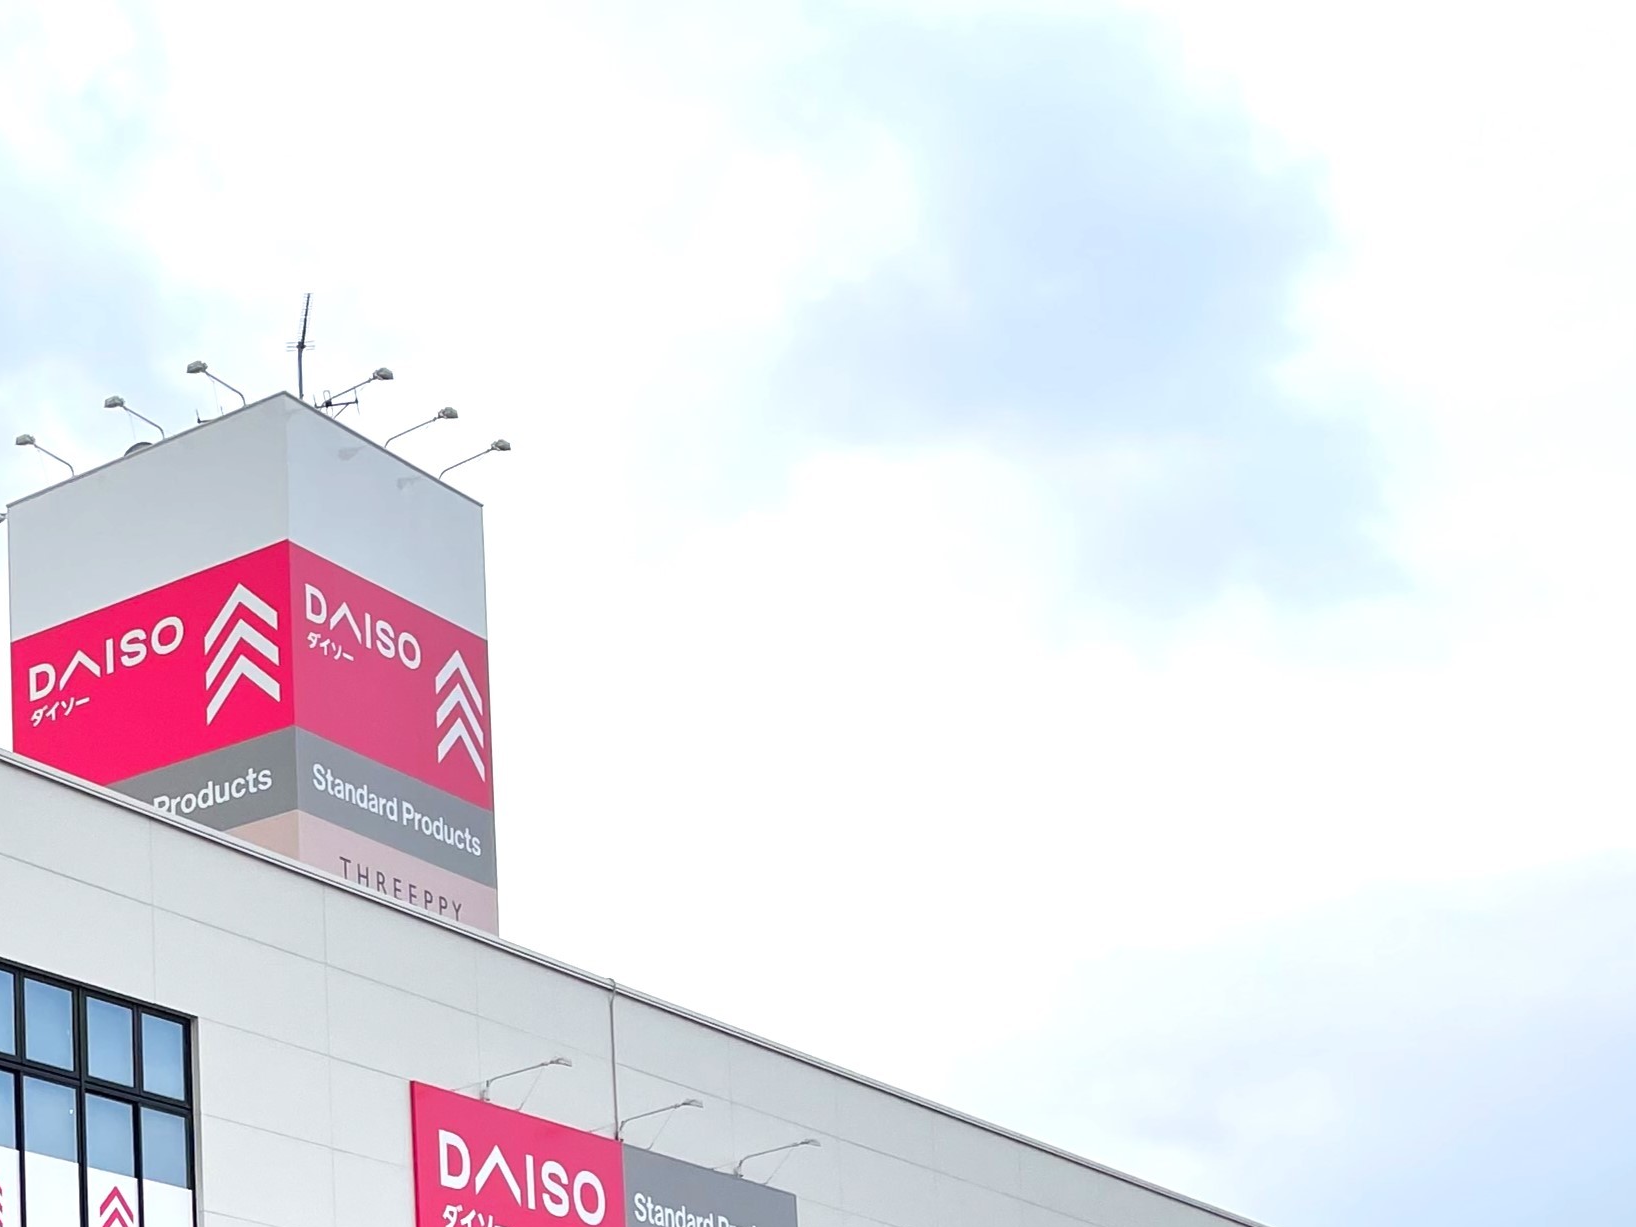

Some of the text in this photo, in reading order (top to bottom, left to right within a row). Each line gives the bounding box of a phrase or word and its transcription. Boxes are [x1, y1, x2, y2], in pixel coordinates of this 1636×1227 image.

[28, 615, 185, 702] DAISO
[305, 583, 422, 670] DAISO
[306, 631, 355, 662] ダイソー
[30, 696, 91, 728] ダイソー
[153, 767, 274, 816] Products
[312, 763, 482, 856] Standard Products
[339, 855, 463, 922] THREEPPY
[438, 1128, 607, 1227] DAISO
